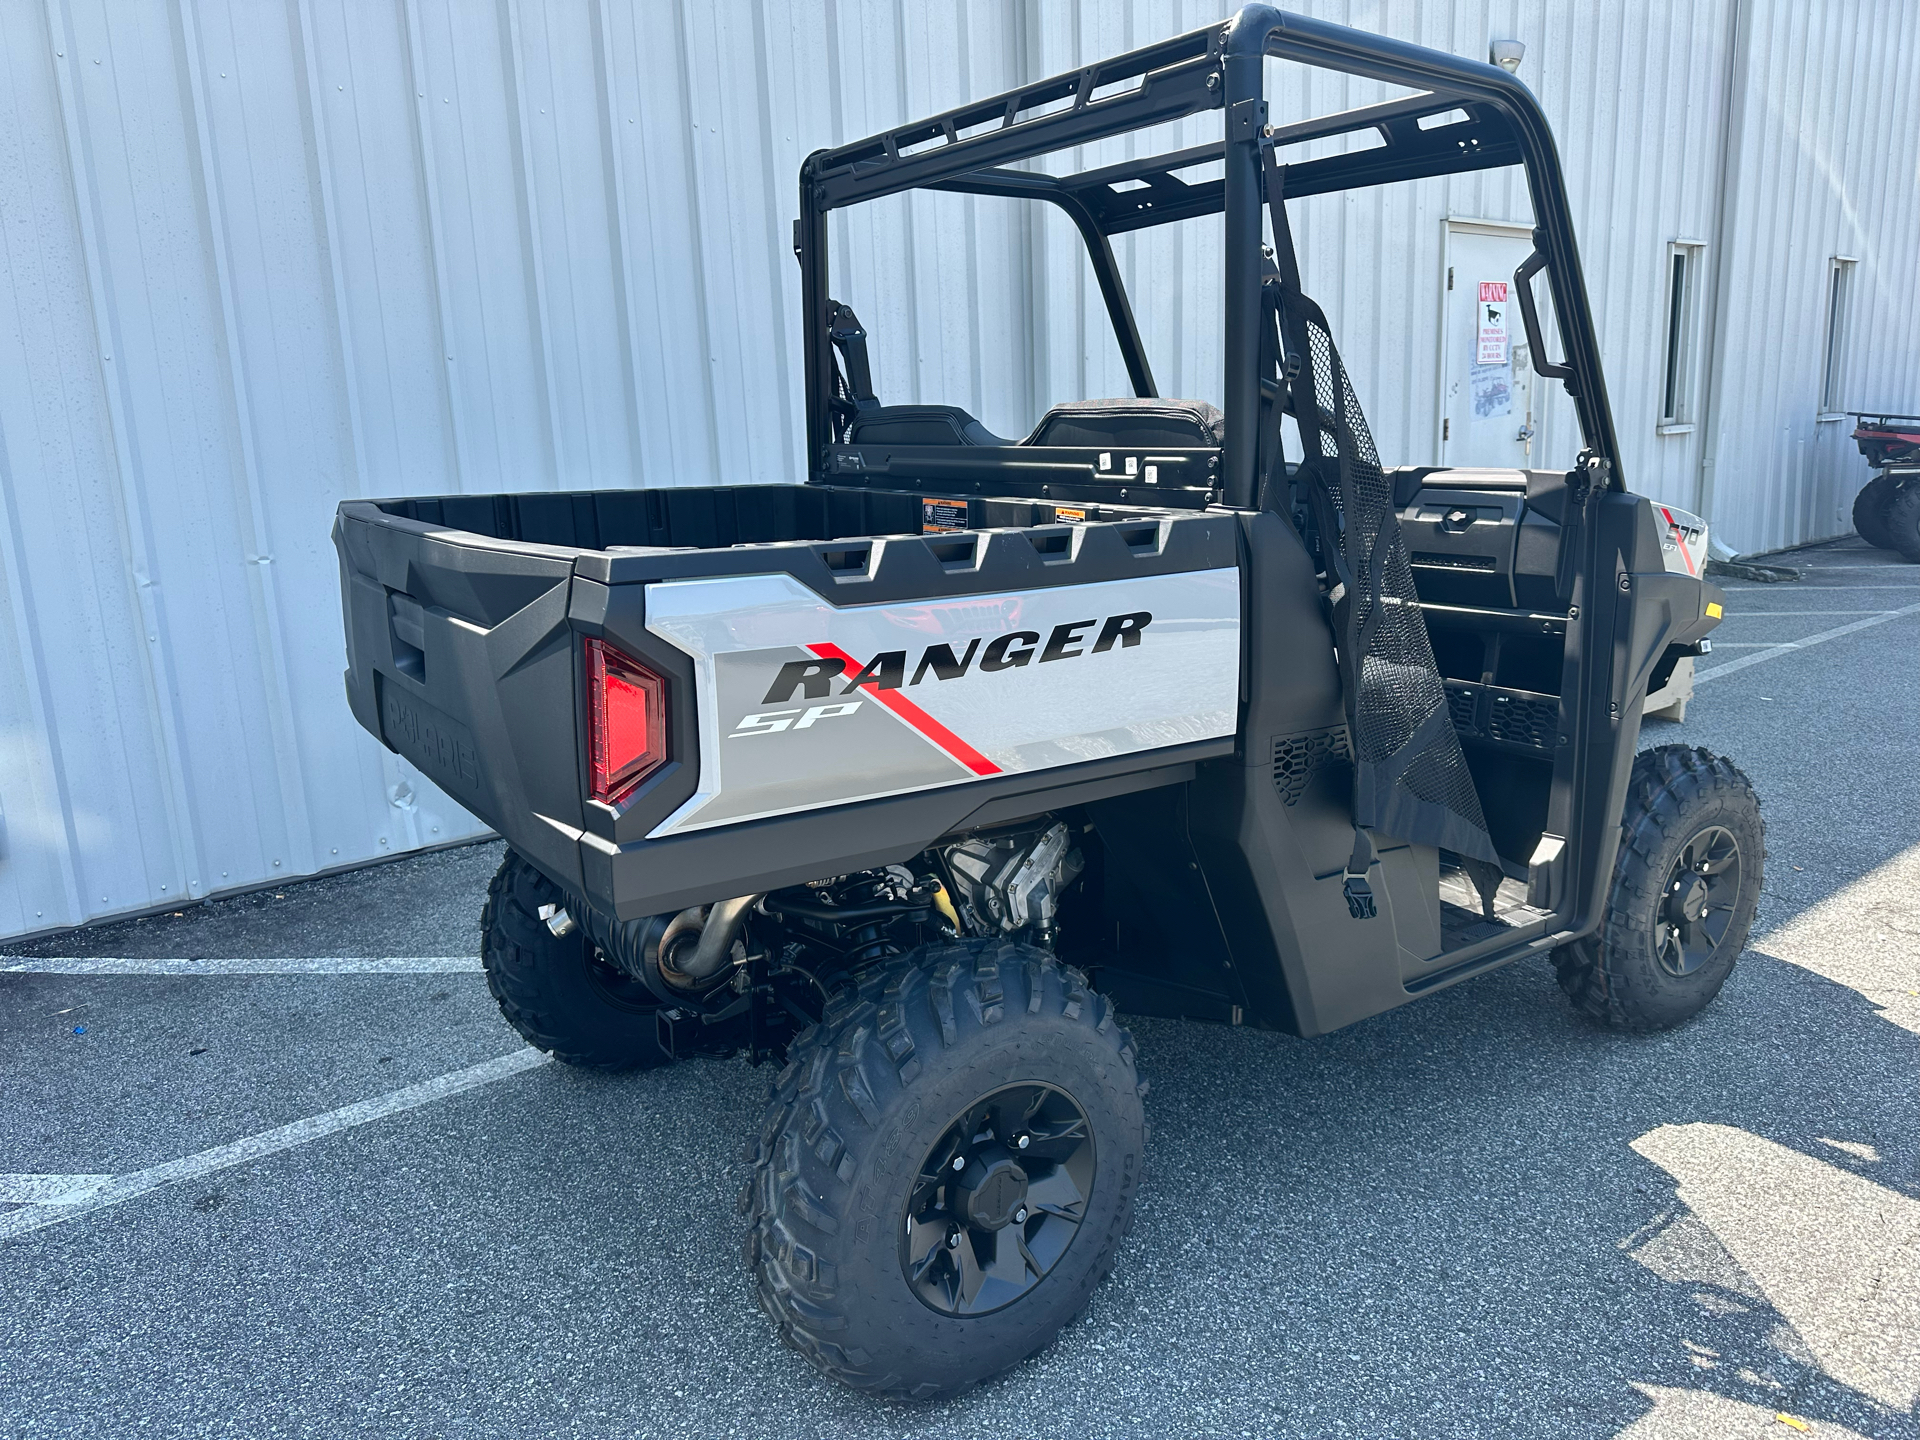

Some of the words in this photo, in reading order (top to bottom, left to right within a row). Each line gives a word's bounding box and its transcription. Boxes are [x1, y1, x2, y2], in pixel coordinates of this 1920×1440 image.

[1480, 284, 1507, 301] WARNING
[1662, 543, 1678, 552] EFI
[1665, 523, 1699, 546] 570
[761, 610, 1153, 705] RANGER
[728, 700, 863, 739] SP
[387, 694, 479, 790] POLARIS
